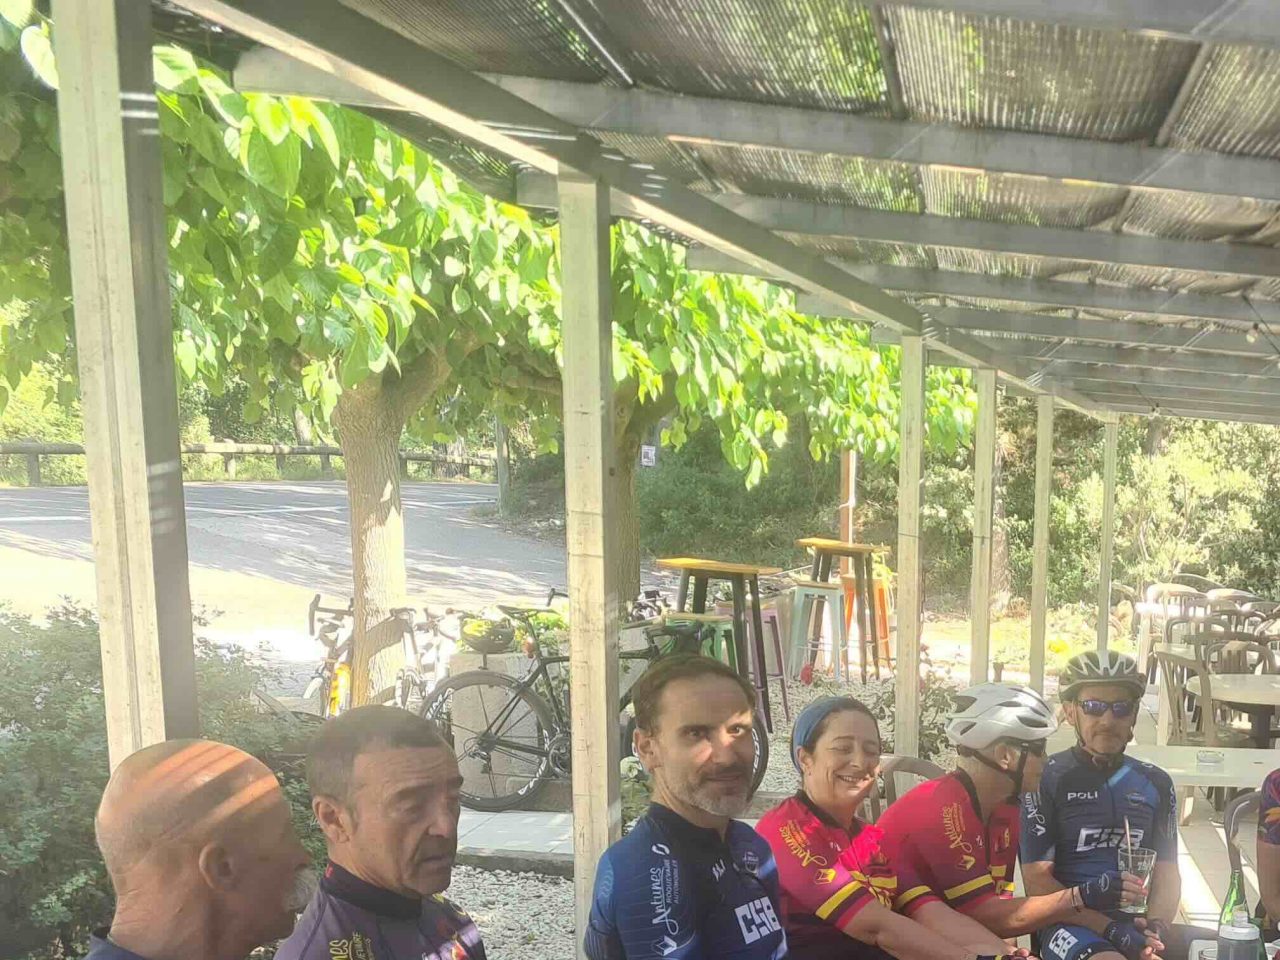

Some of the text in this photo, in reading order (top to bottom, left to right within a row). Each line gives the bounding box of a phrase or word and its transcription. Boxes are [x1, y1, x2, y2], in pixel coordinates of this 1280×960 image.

[1068, 791, 1098, 800] POLI
[650, 868, 679, 935] Antunes
[734, 896, 781, 945] CSB
[1048, 928, 1079, 960] CSB
